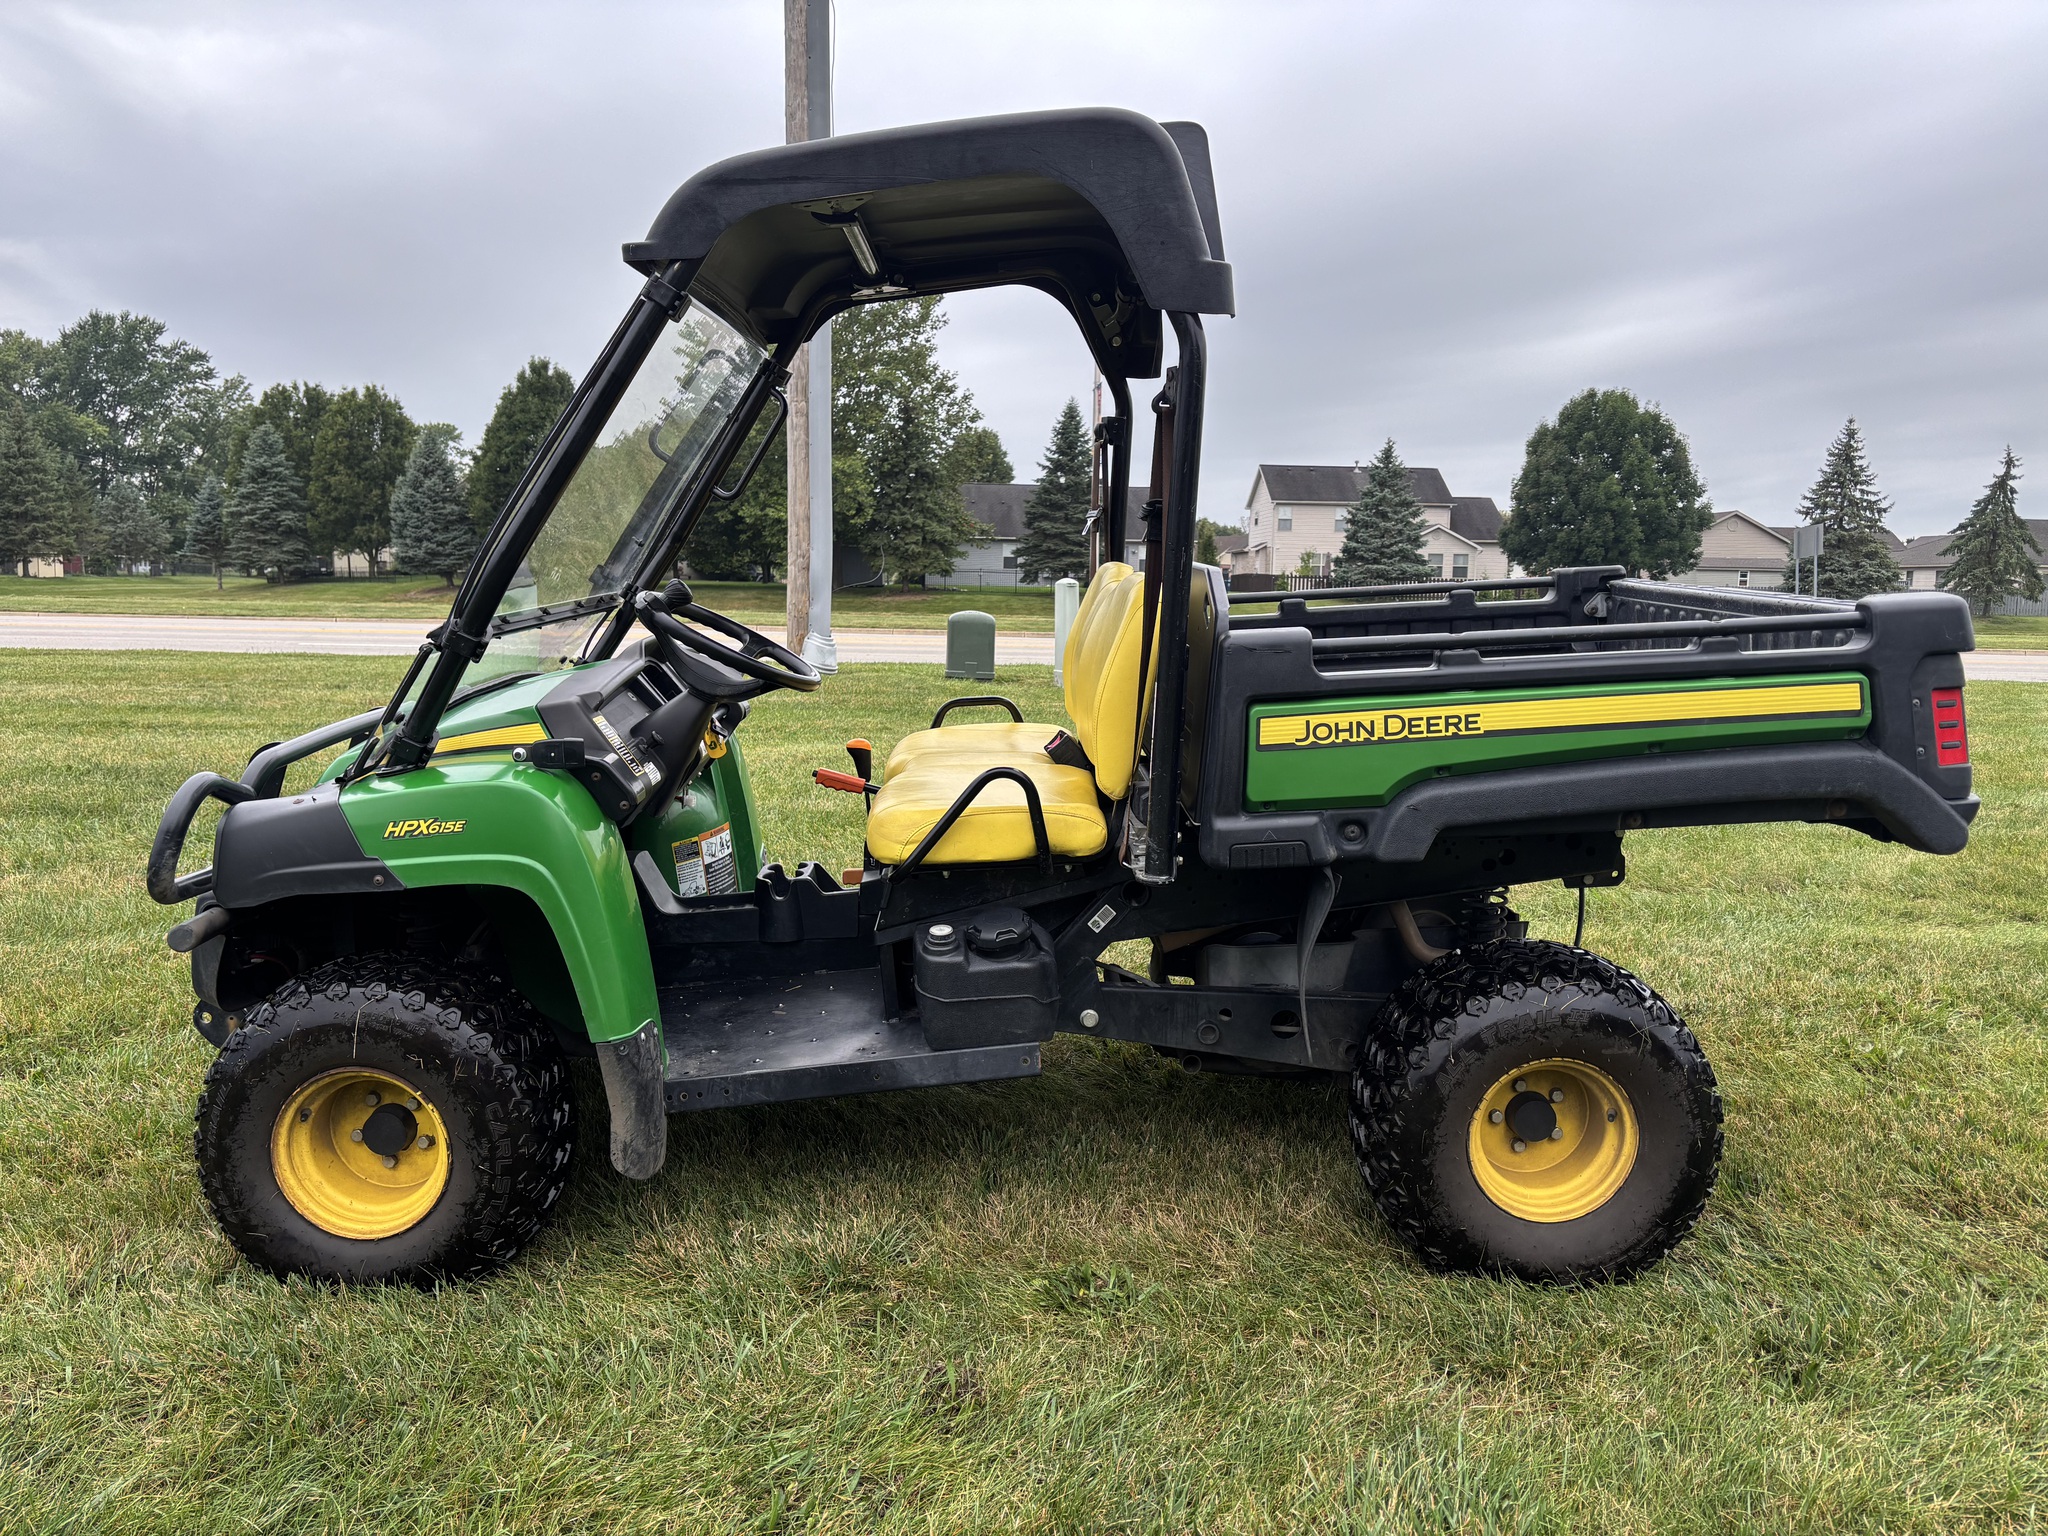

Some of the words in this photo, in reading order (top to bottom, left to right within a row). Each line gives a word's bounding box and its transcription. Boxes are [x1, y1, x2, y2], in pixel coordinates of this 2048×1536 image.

[1294, 719, 1375, 743] JOHN
[1383, 713, 1482, 738] DEERE
[383, 818, 467, 838] HPX615E
[1435, 1047, 1480, 1095] ALL
[1480, 1008, 1561, 1047] TRAIL
